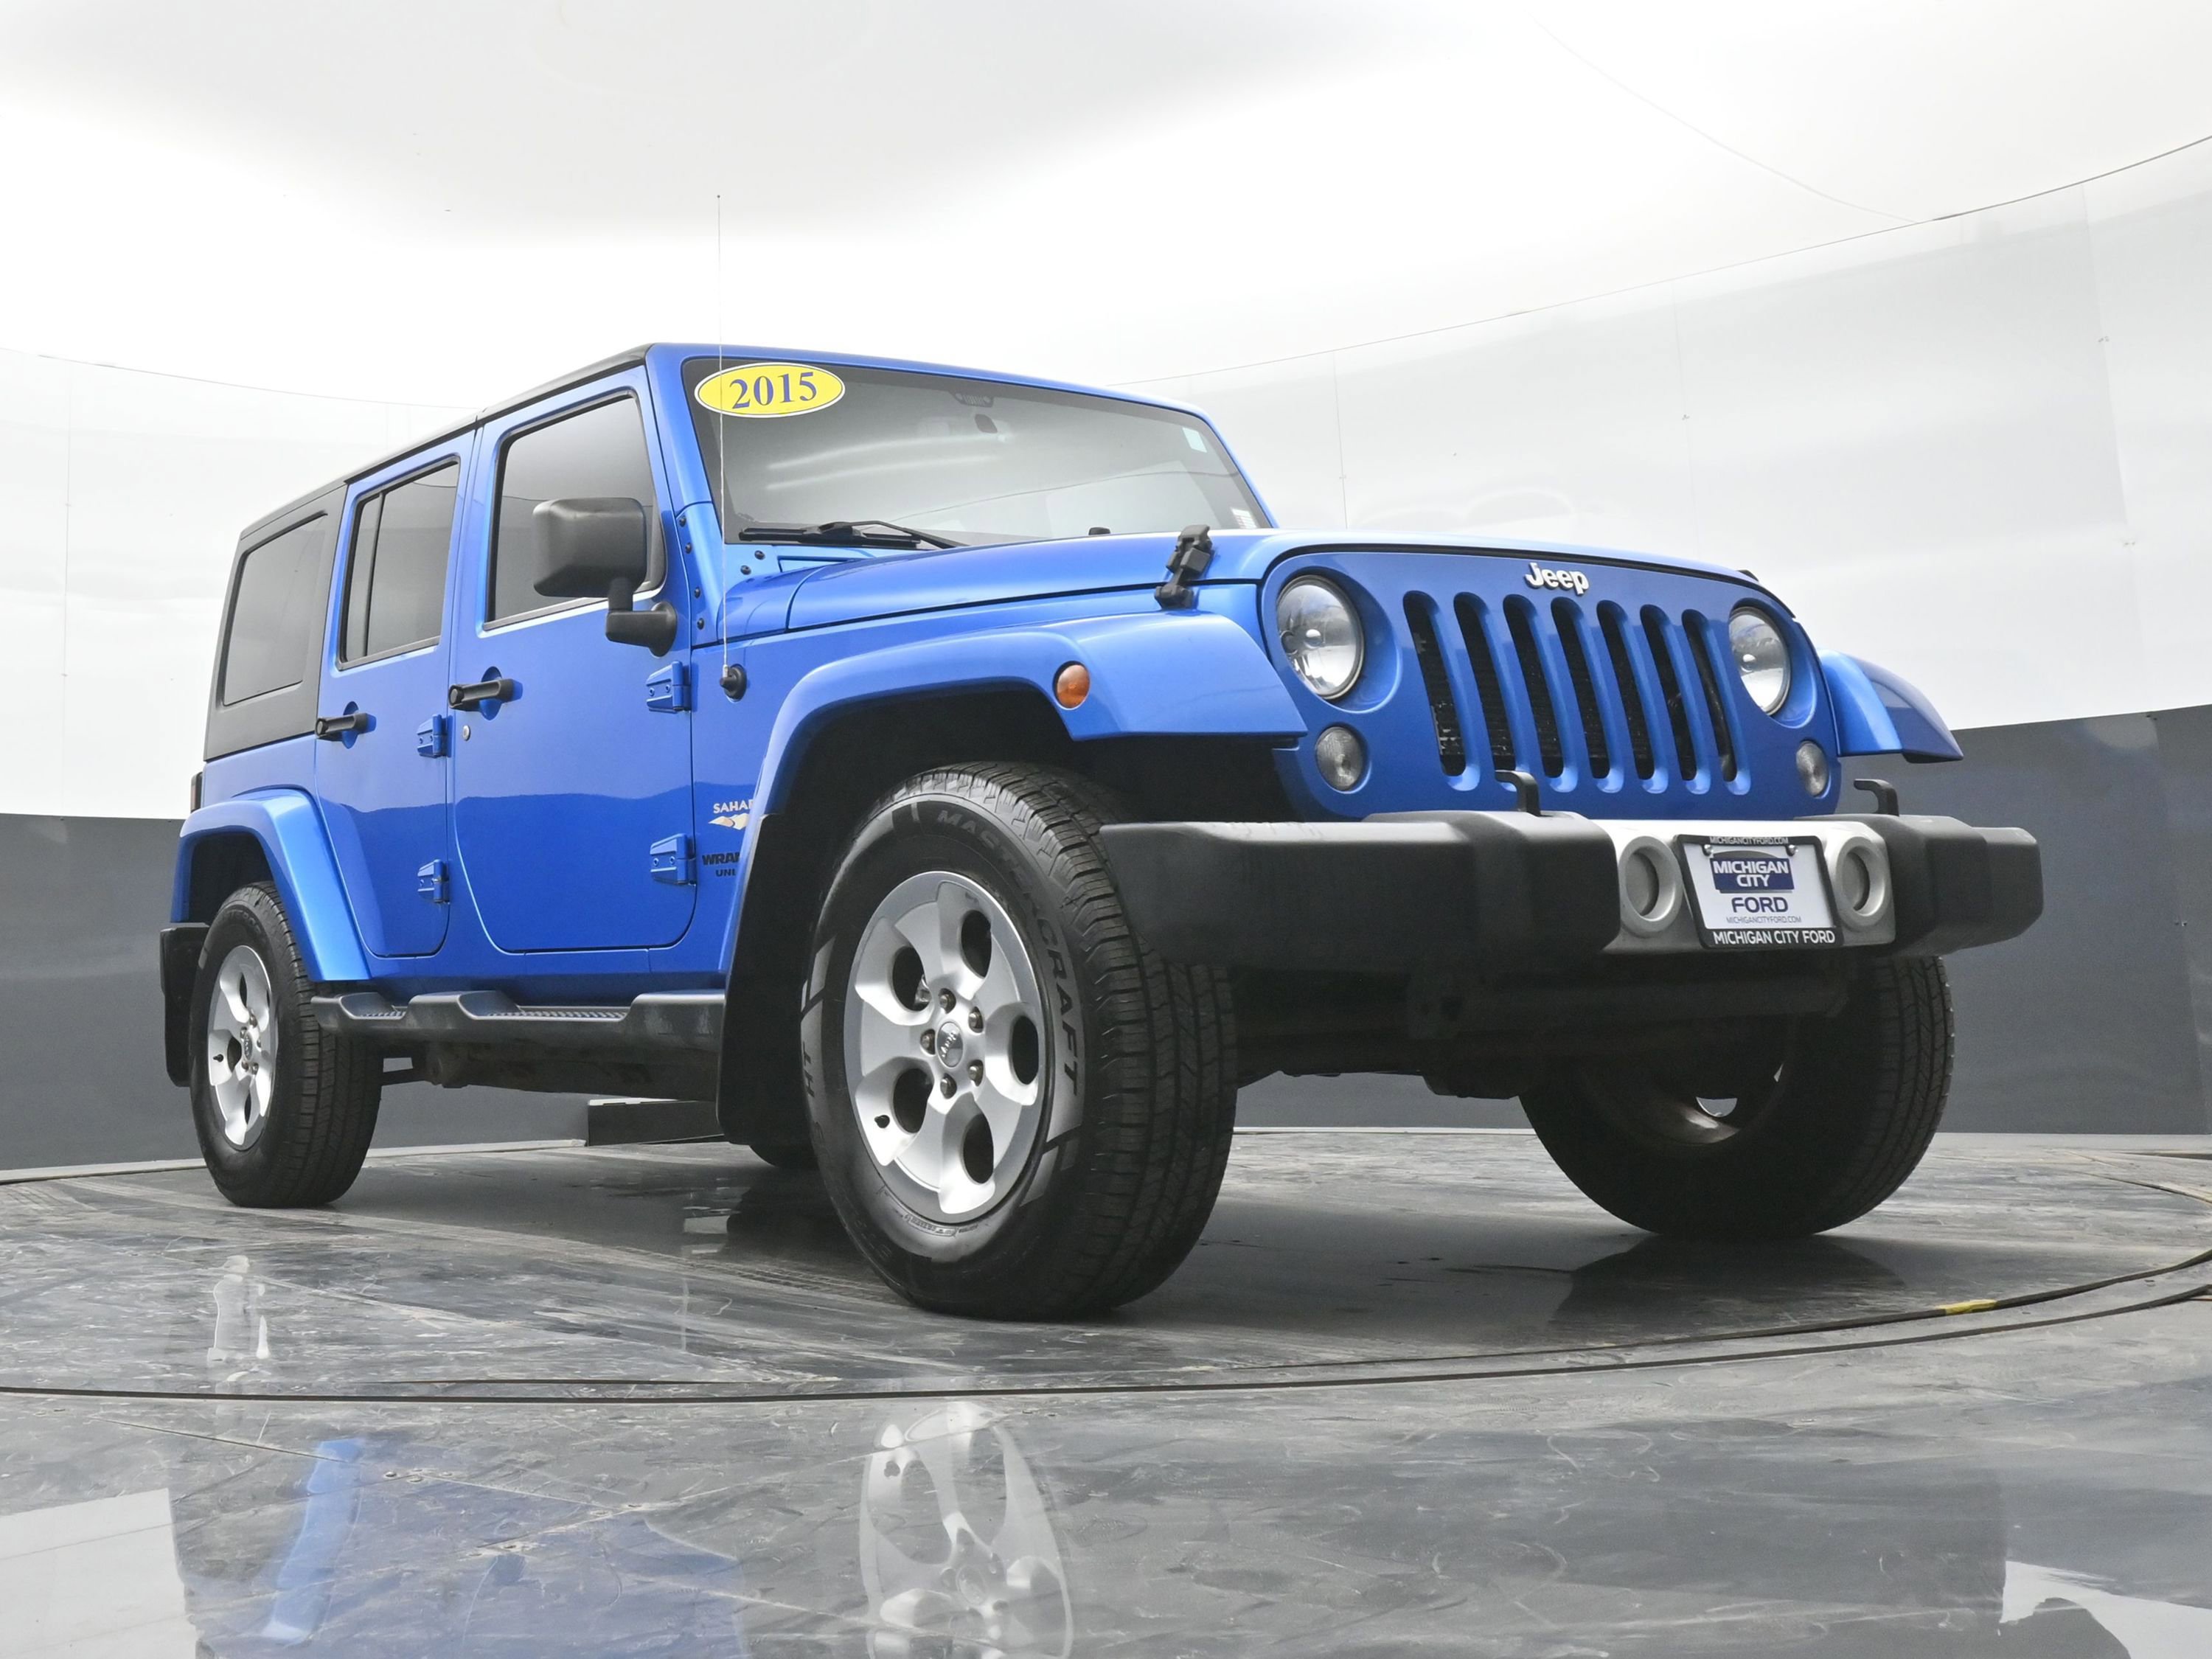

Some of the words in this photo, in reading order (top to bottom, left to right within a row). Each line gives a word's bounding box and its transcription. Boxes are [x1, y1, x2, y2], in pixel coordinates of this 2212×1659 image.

[729, 372, 817, 409] 2015
[1524, 562, 1590, 596] Jeep
[1709, 836, 1790, 845] MICHIGANCITYFORD.COM
[1713, 860, 1790, 874] MICHIGAN
[1736, 874, 1771, 888] CITY
[1731, 897, 1789, 914] FORD
[1726, 916, 1802, 924] MICHIGANCITYFORD.COM
[1713, 931, 1772, 945] MICHIGAN
[1774, 931, 1800, 945] CITY
[1803, 930, 1836, 944] FORD
